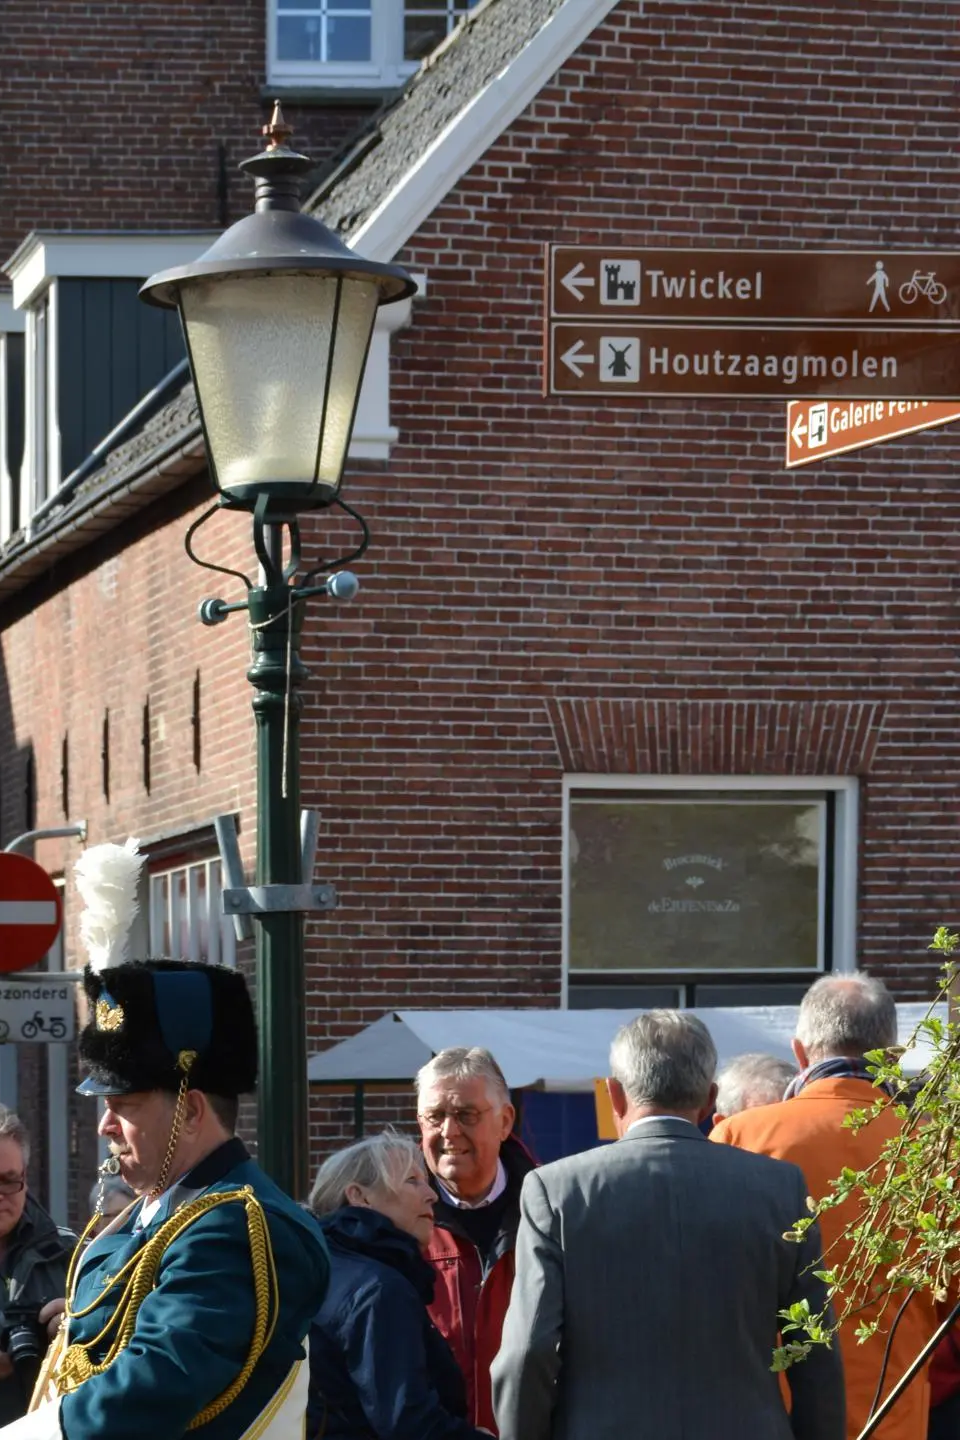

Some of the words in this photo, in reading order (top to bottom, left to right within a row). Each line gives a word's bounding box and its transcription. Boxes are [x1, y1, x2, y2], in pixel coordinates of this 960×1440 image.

[645, 269, 763, 300] Twickel
[648, 346, 898, 384] Houtzaagmolen
[830, 401, 885, 433] Galerie
